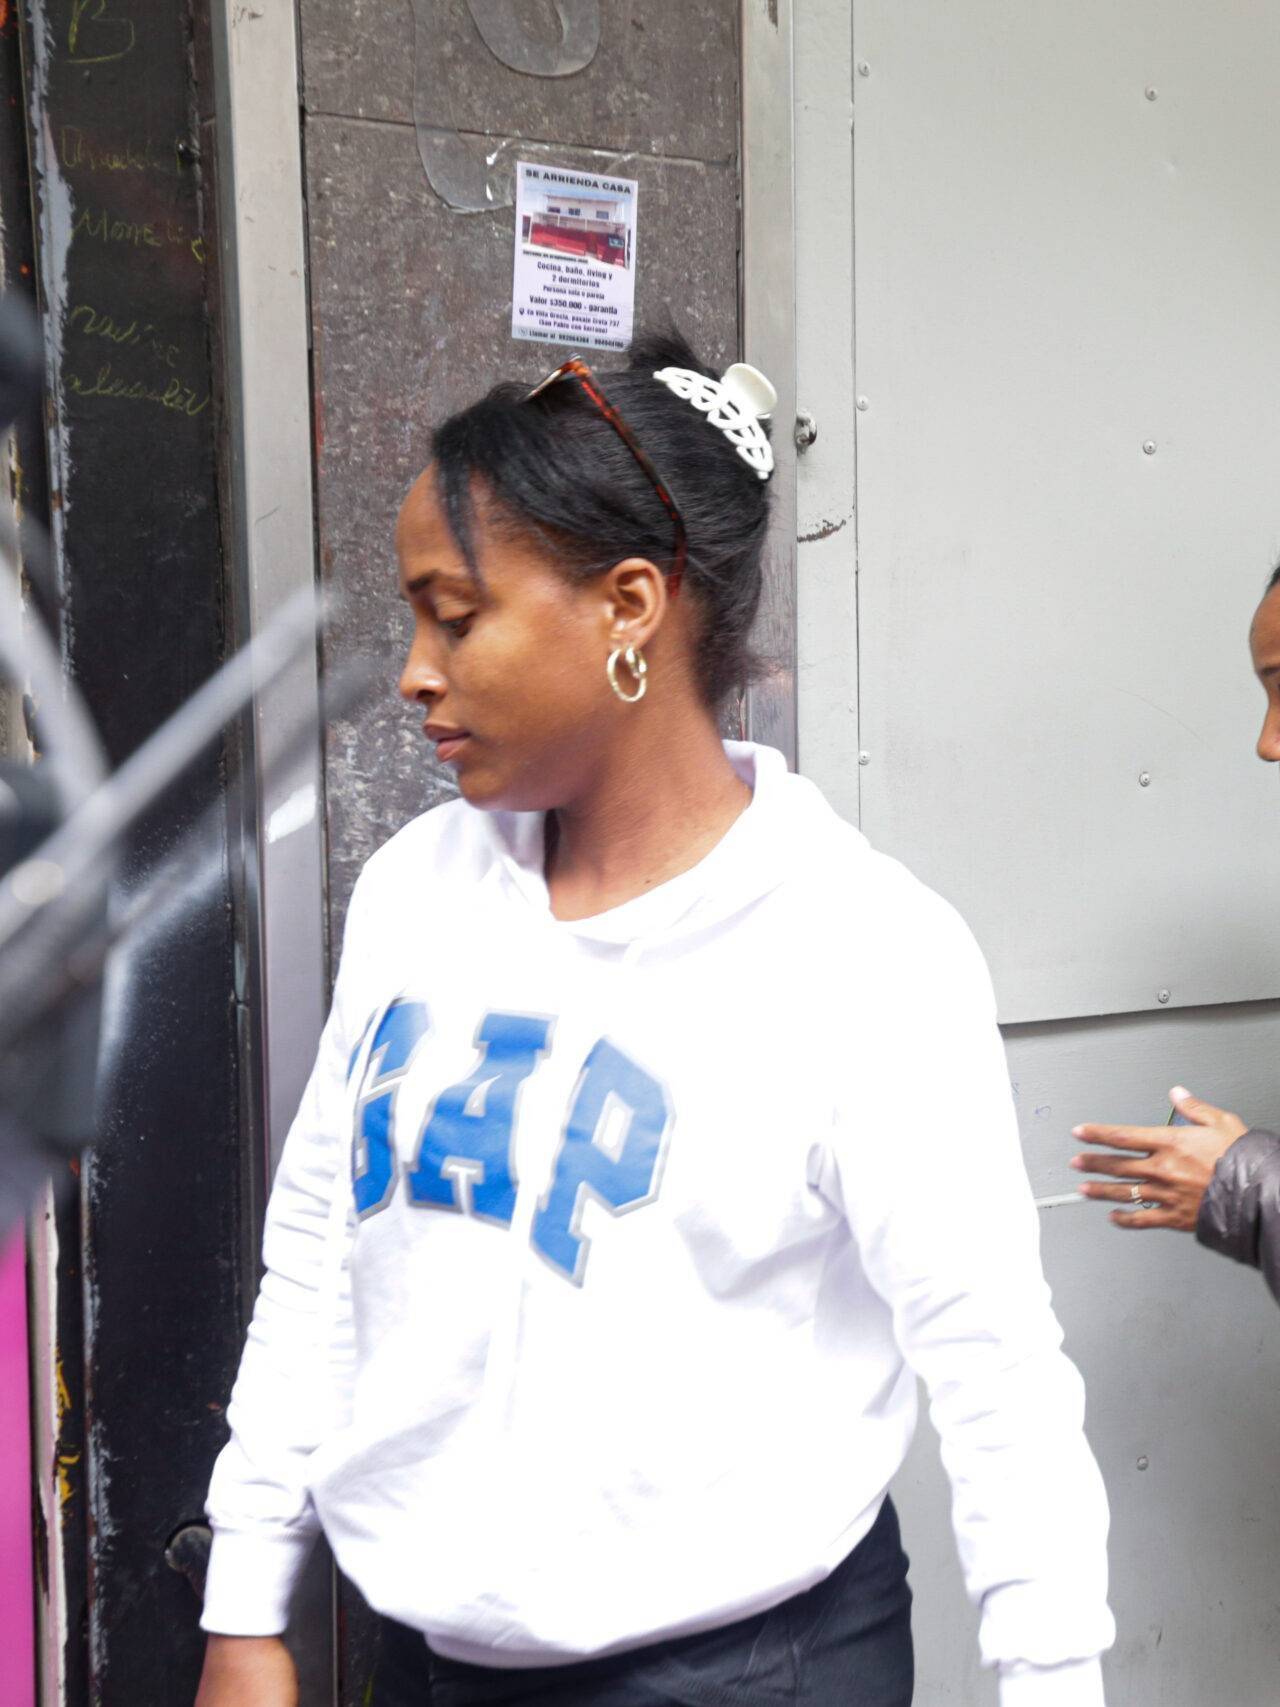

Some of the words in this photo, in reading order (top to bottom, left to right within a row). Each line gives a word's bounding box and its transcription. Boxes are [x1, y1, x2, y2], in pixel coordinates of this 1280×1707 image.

[525, 169, 540, 178] SE
[543, 172, 599, 189] ARRIENDA
[602, 183, 631, 194] CASA
[537, 261, 564, 273] Cocina,
[565, 265, 585, 276] baño,
[587, 269, 607, 280] living
[558, 275, 600, 288] dormitorios
[529, 295, 548, 305] Valor
